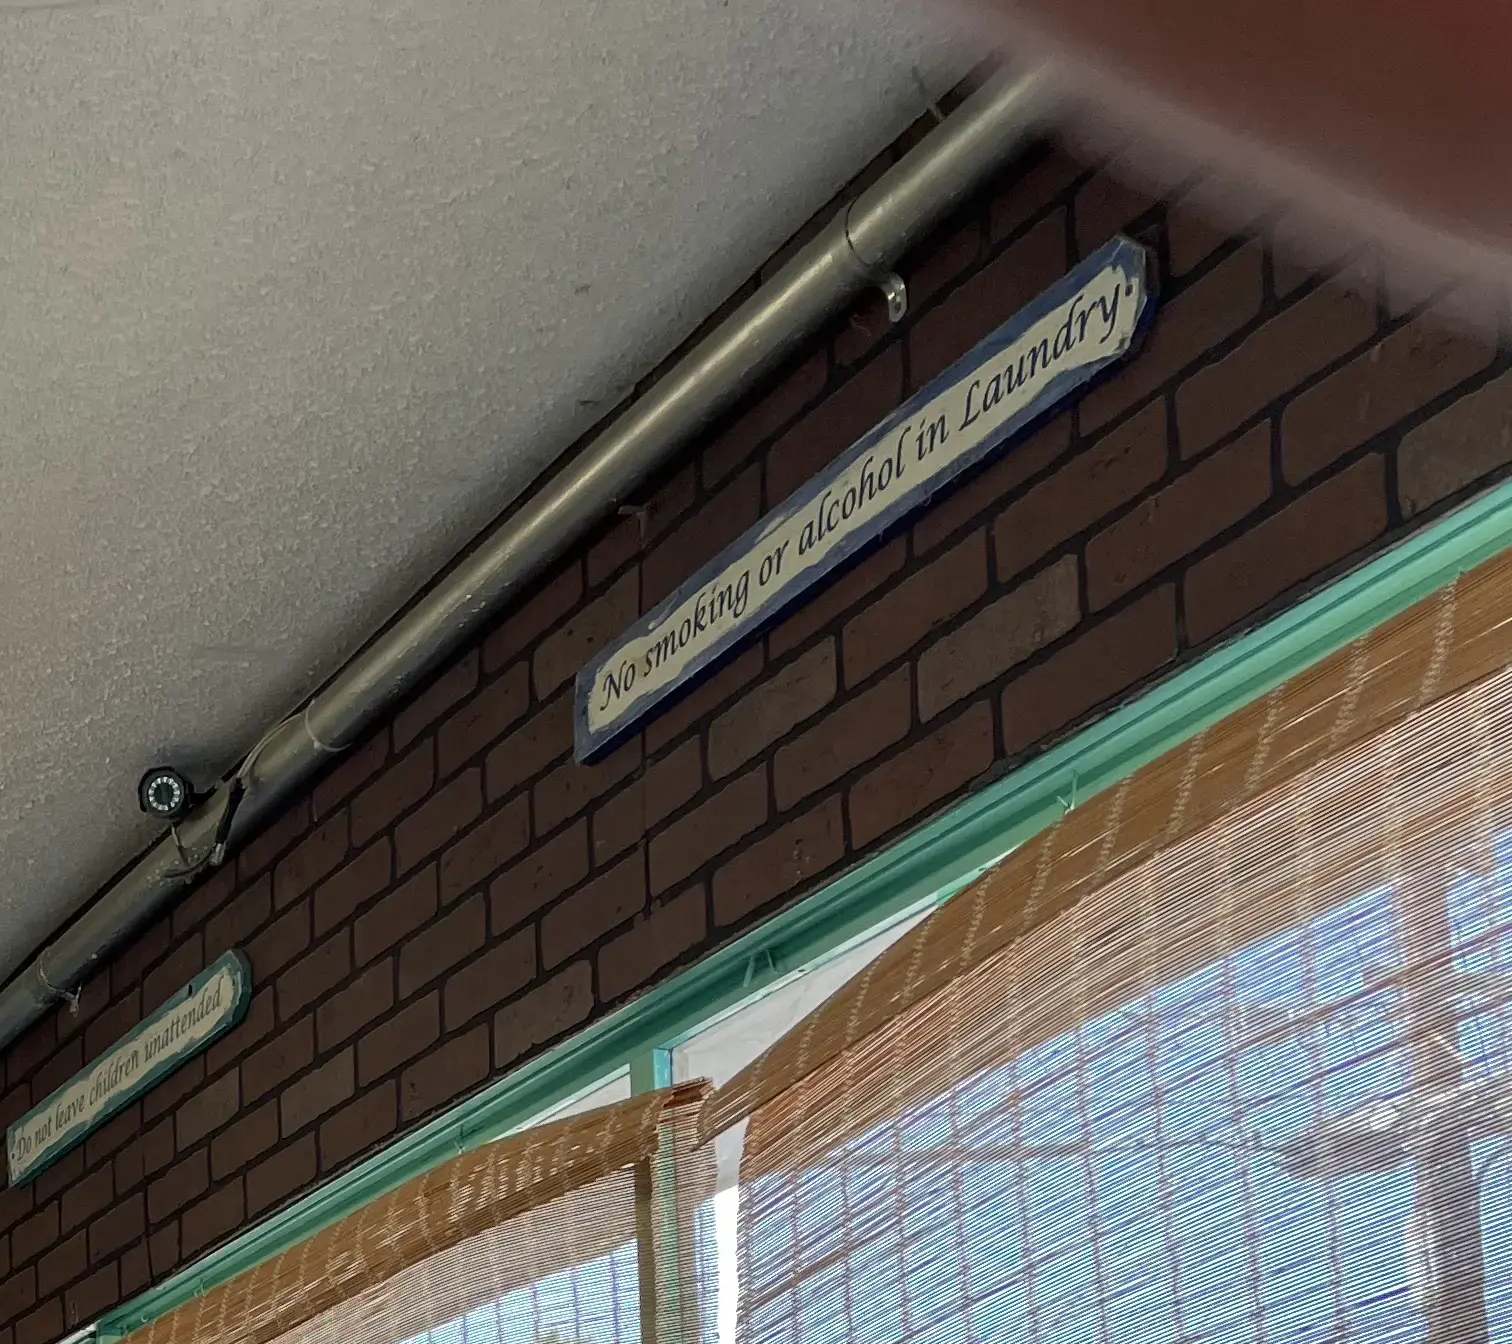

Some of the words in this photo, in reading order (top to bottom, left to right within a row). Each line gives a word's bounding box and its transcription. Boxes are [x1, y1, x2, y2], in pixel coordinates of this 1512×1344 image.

[600, 660, 636, 712] No
[643, 569, 750, 678] smoking
[758, 539, 790, 588] or
[798, 426, 911, 556] alcohol
[916, 411, 950, 463] in
[16, 1135, 33, 1162] Do
[35, 1115, 52, 1146] not
[54, 1095, 85, 1132] leave
[89, 1051, 140, 1106] children
[143, 975, 225, 1062] unattended
